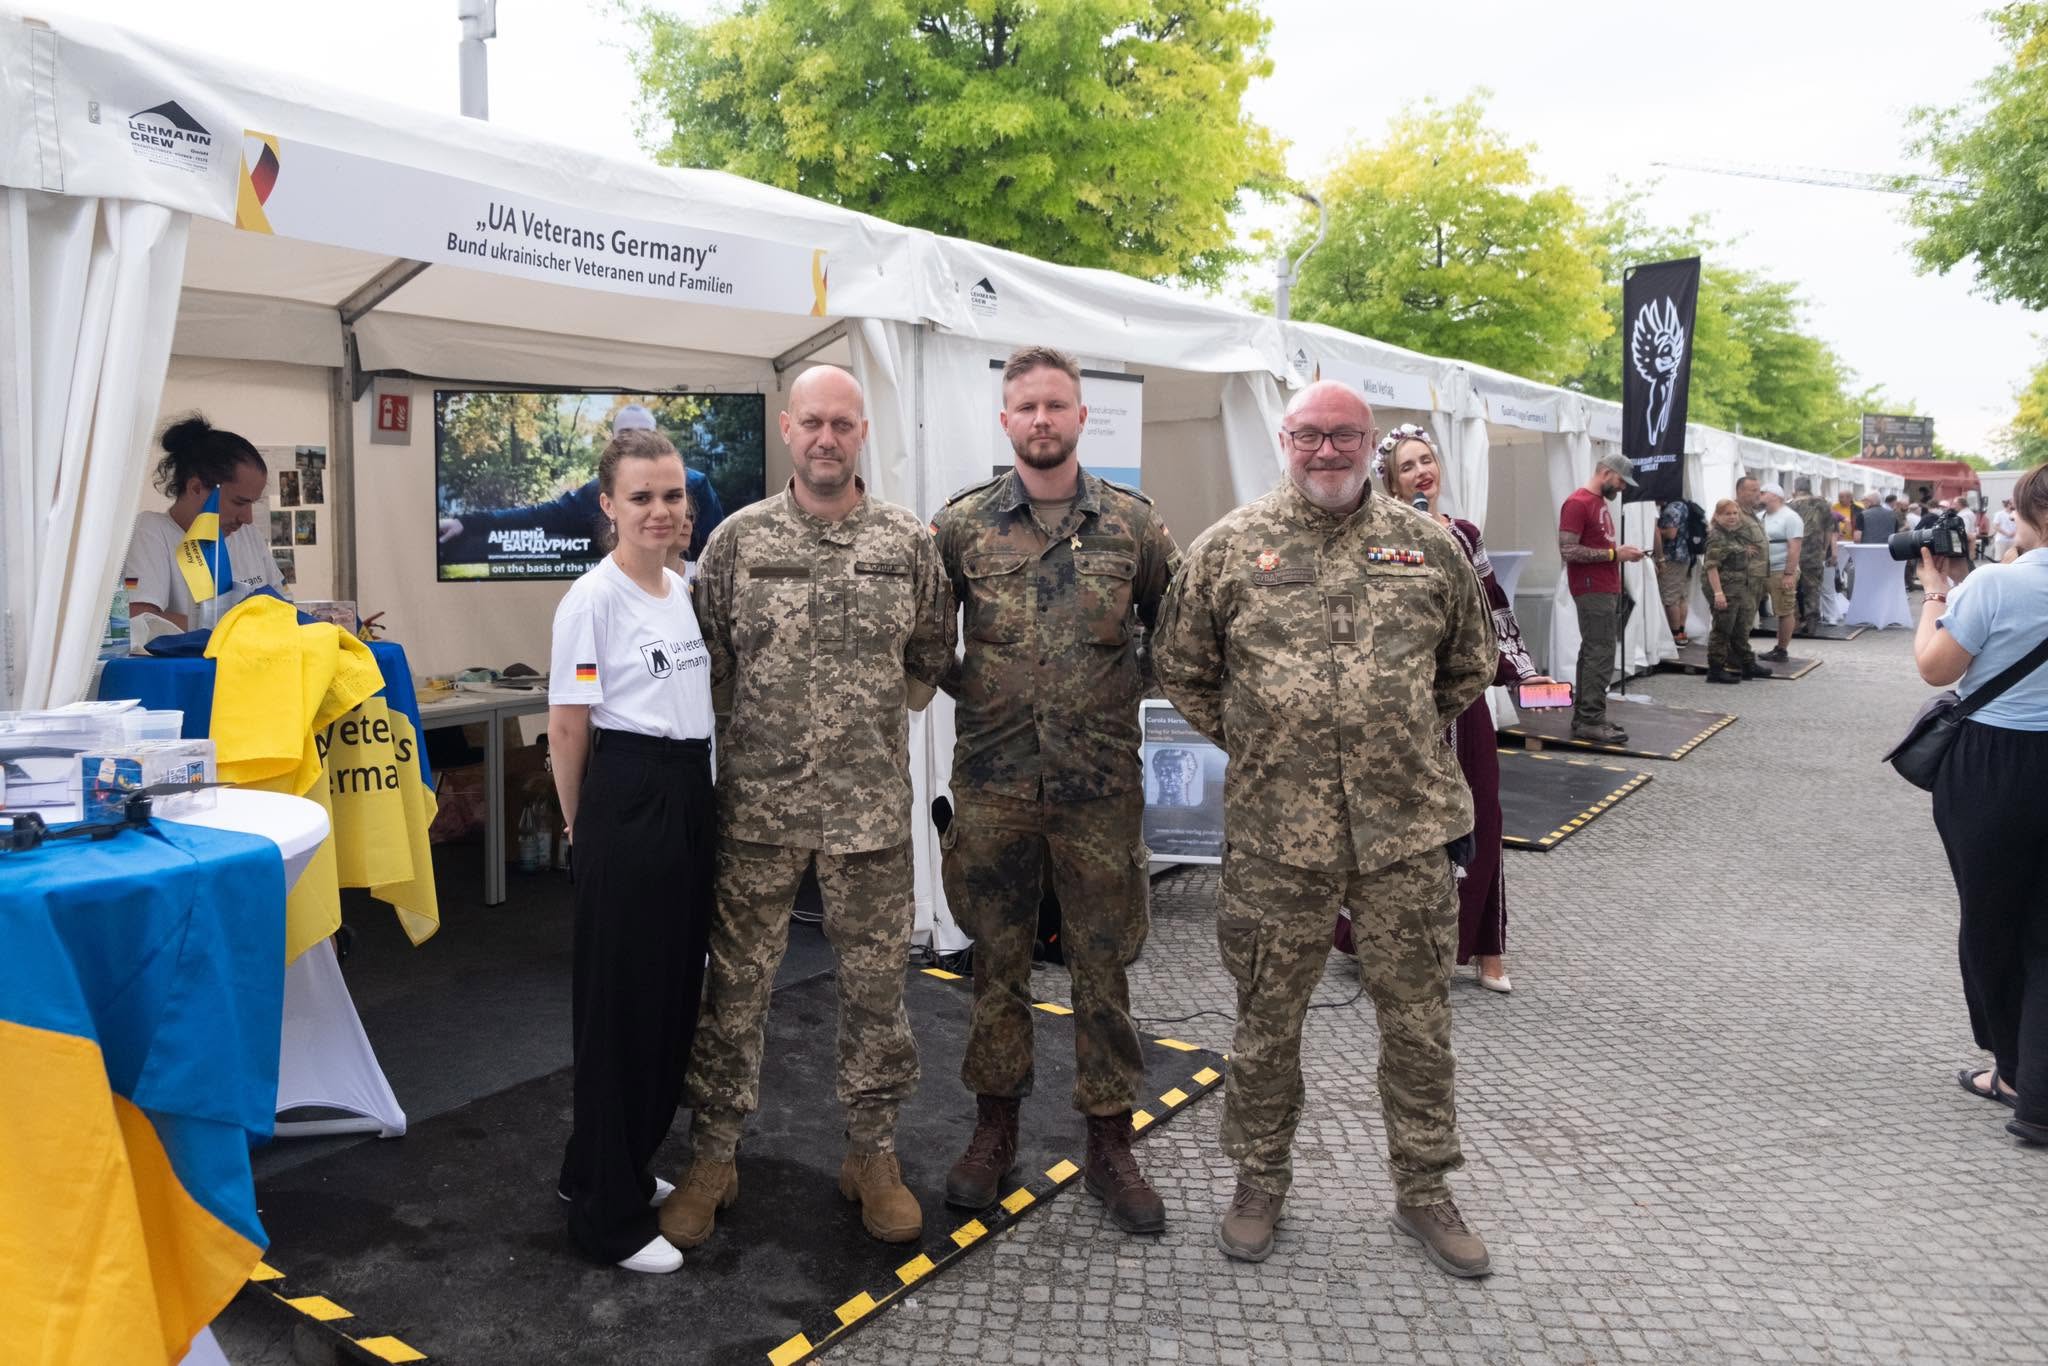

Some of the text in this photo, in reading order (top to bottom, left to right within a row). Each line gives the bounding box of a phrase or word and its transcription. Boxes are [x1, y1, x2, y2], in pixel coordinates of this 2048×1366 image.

[128, 120, 211, 146] LEHMANN
[130, 131, 174, 149] CREW
[521, 210, 605, 251] Veterans
[447, 232, 734, 295] Bund ukrainischer Veteranen und Familien
[502, 538, 591, 554] БАНДУРИСТ
[491, 566, 505, 574] on
[507, 563, 525, 573] the
[527, 563, 552, 573] basis
[554, 562, 565, 572] of
[566, 562, 583, 572] the
[676, 655, 708, 671] Germany
